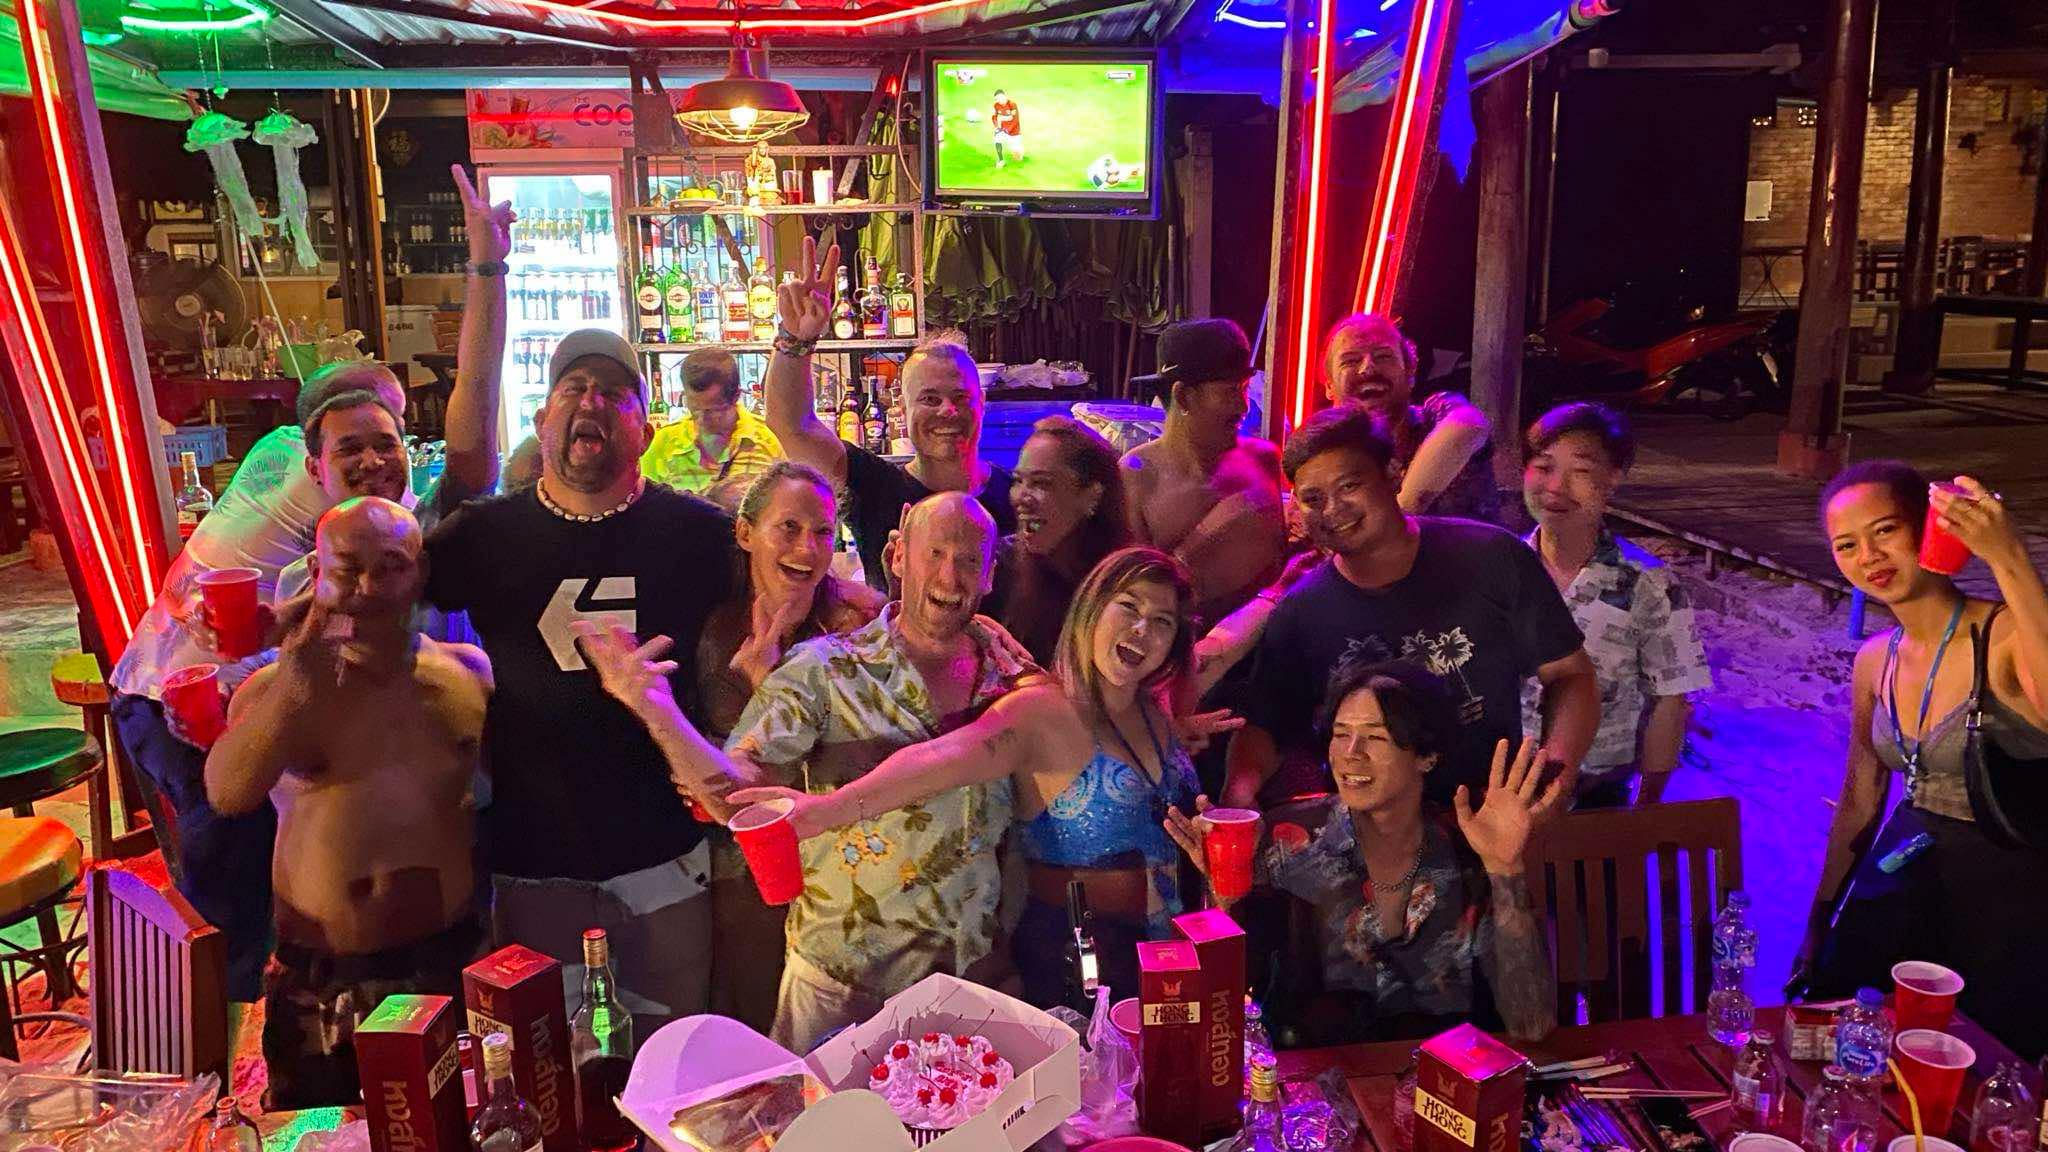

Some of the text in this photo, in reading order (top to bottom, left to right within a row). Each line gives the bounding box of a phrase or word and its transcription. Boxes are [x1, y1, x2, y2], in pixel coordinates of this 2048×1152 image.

[573, 103, 633, 126] COO
[1152, 1013, 1194, 1024] THONG
[1155, 1005, 1190, 1015] HONG
[1421, 1104, 1468, 1140] THONG
[1426, 1097, 1464, 1127] HONG
